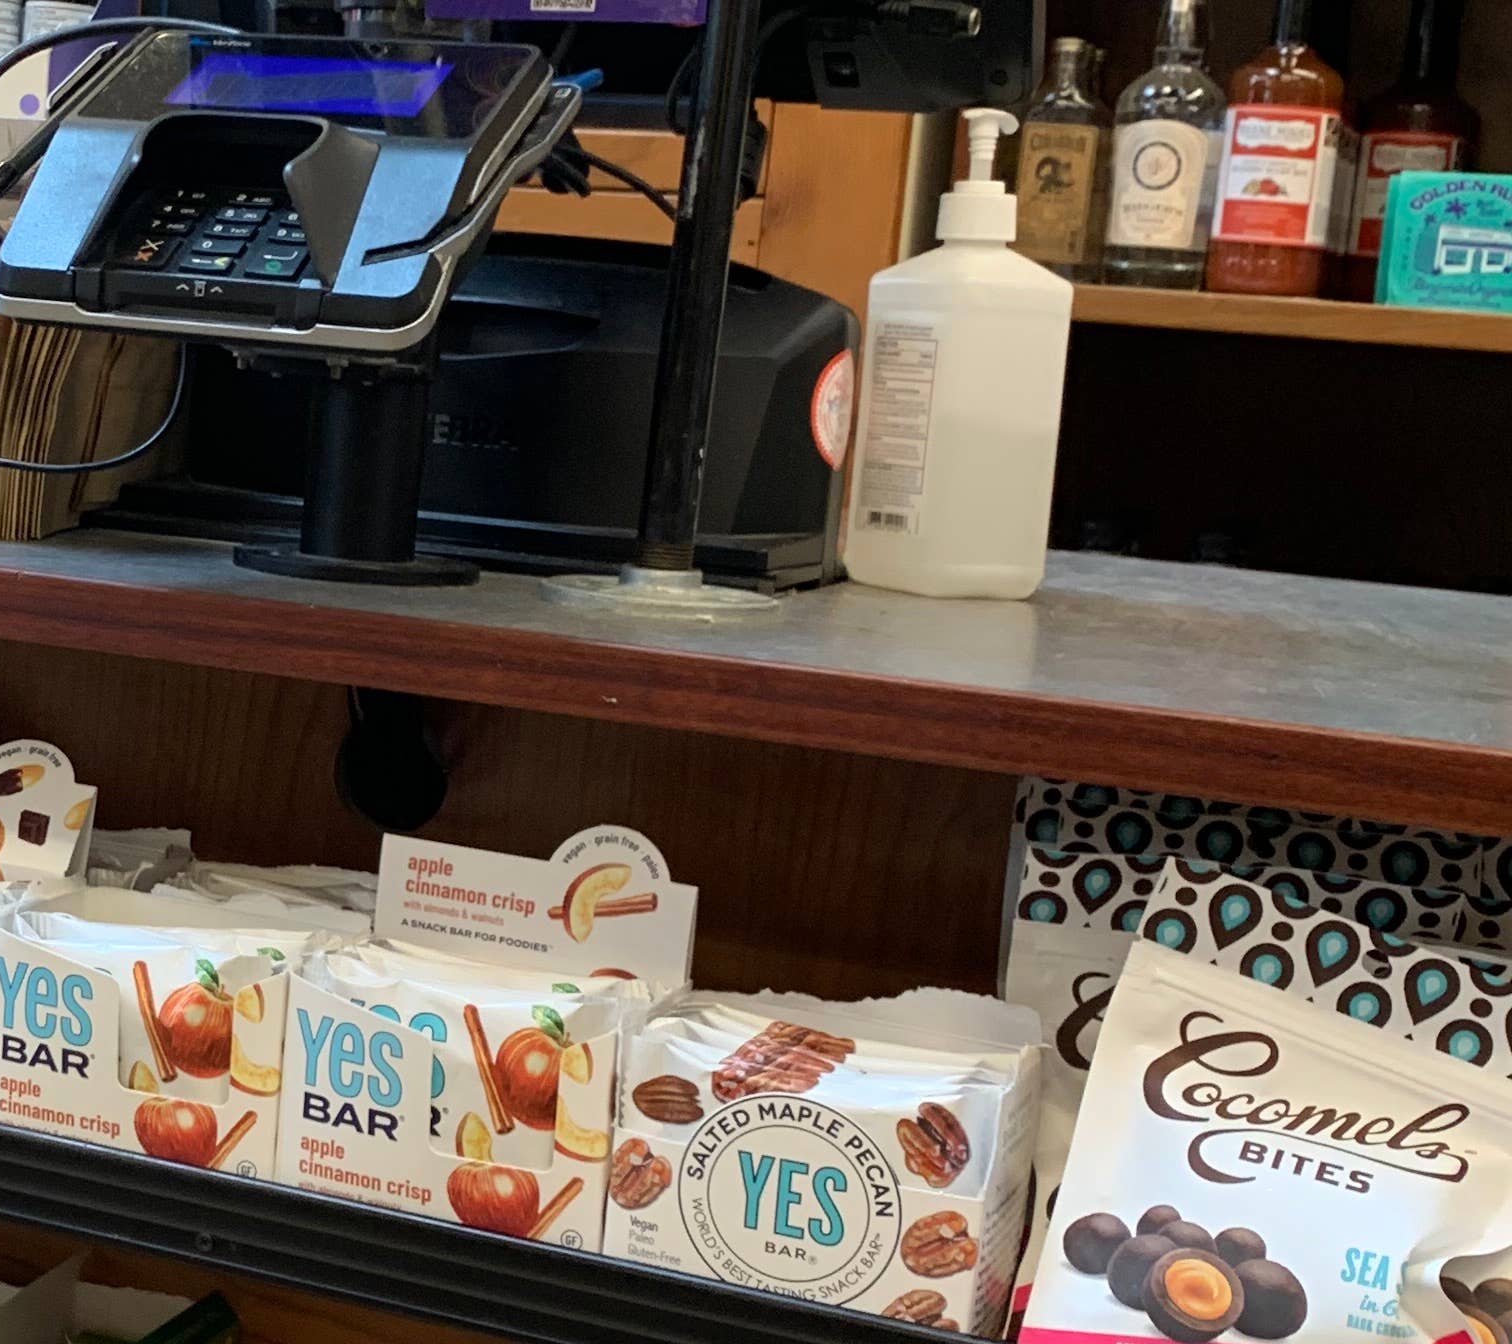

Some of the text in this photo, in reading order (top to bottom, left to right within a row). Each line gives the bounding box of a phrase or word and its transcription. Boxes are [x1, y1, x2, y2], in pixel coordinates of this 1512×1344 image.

[408, 856, 453, 878] apple
[406, 878, 535, 917] cinnamon crisp
[0, 1075, 41, 1100] apple
[1141, 1010, 1470, 1169] Cocomels
[0, 1096, 121, 1140] cinnamon crisp
[688, 1102, 894, 1217] SALTED MAPLE PECAN
[1238, 1140, 1374, 1195] BITES
[738, 1150, 847, 1246] YES
[1340, 1246, 1390, 1291] SEA
